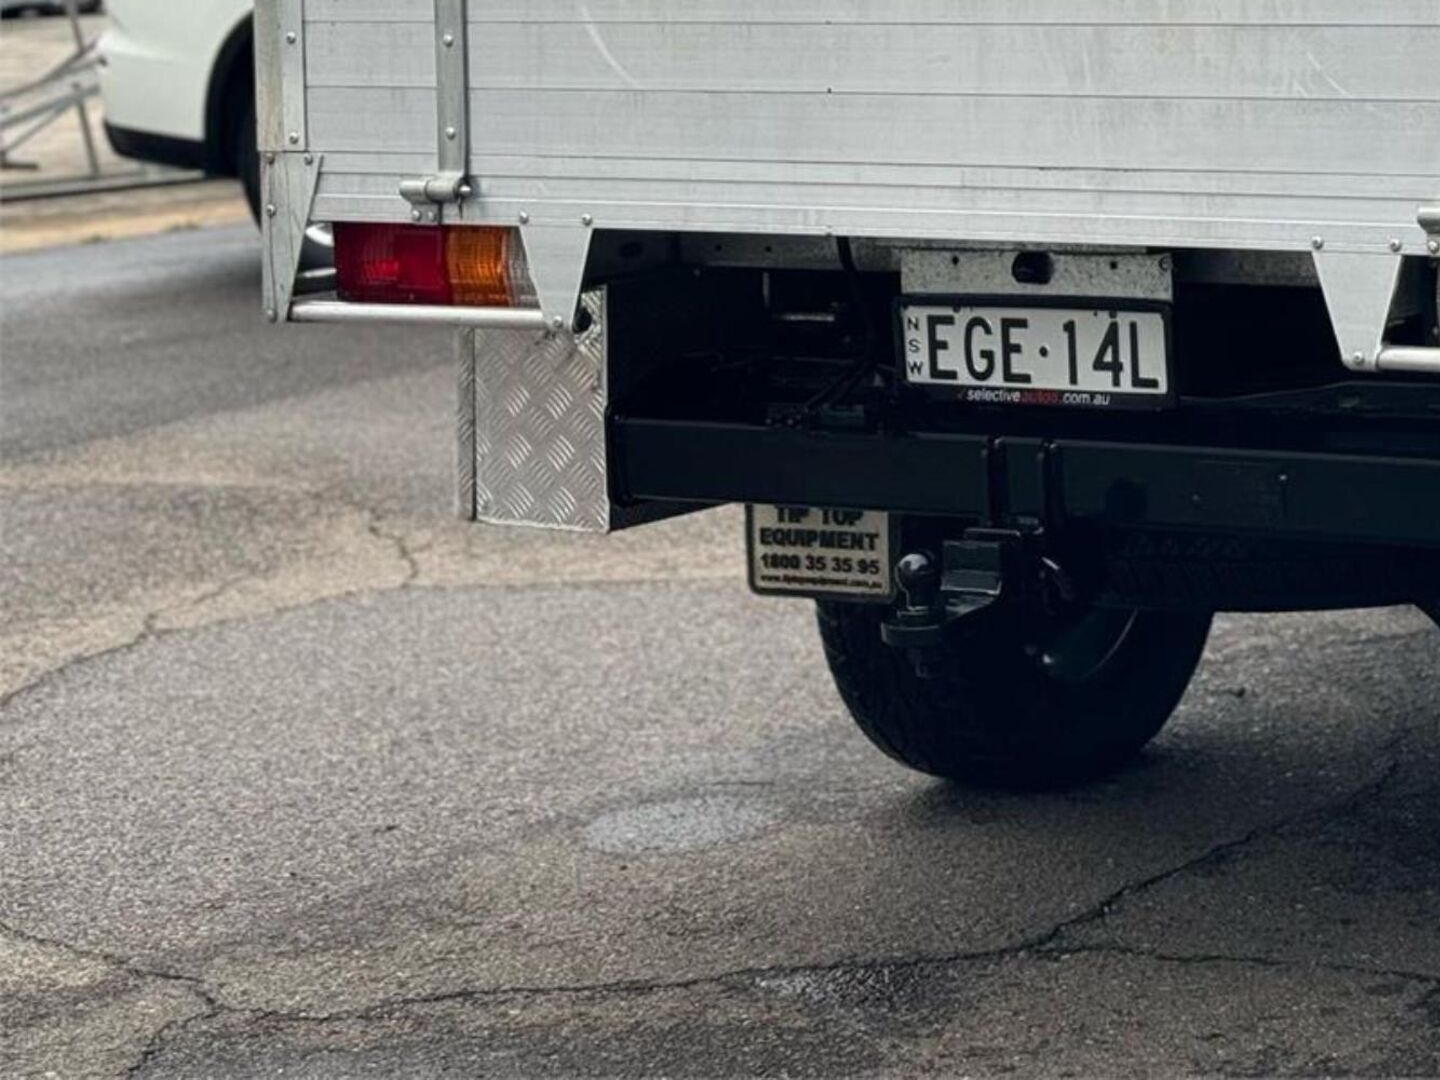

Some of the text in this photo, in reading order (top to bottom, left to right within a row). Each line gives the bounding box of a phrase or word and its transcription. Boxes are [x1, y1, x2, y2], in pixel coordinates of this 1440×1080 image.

[760, 527, 879, 551] EQUIPMENT
[760, 552, 880, 575] 1800 35 35 95
